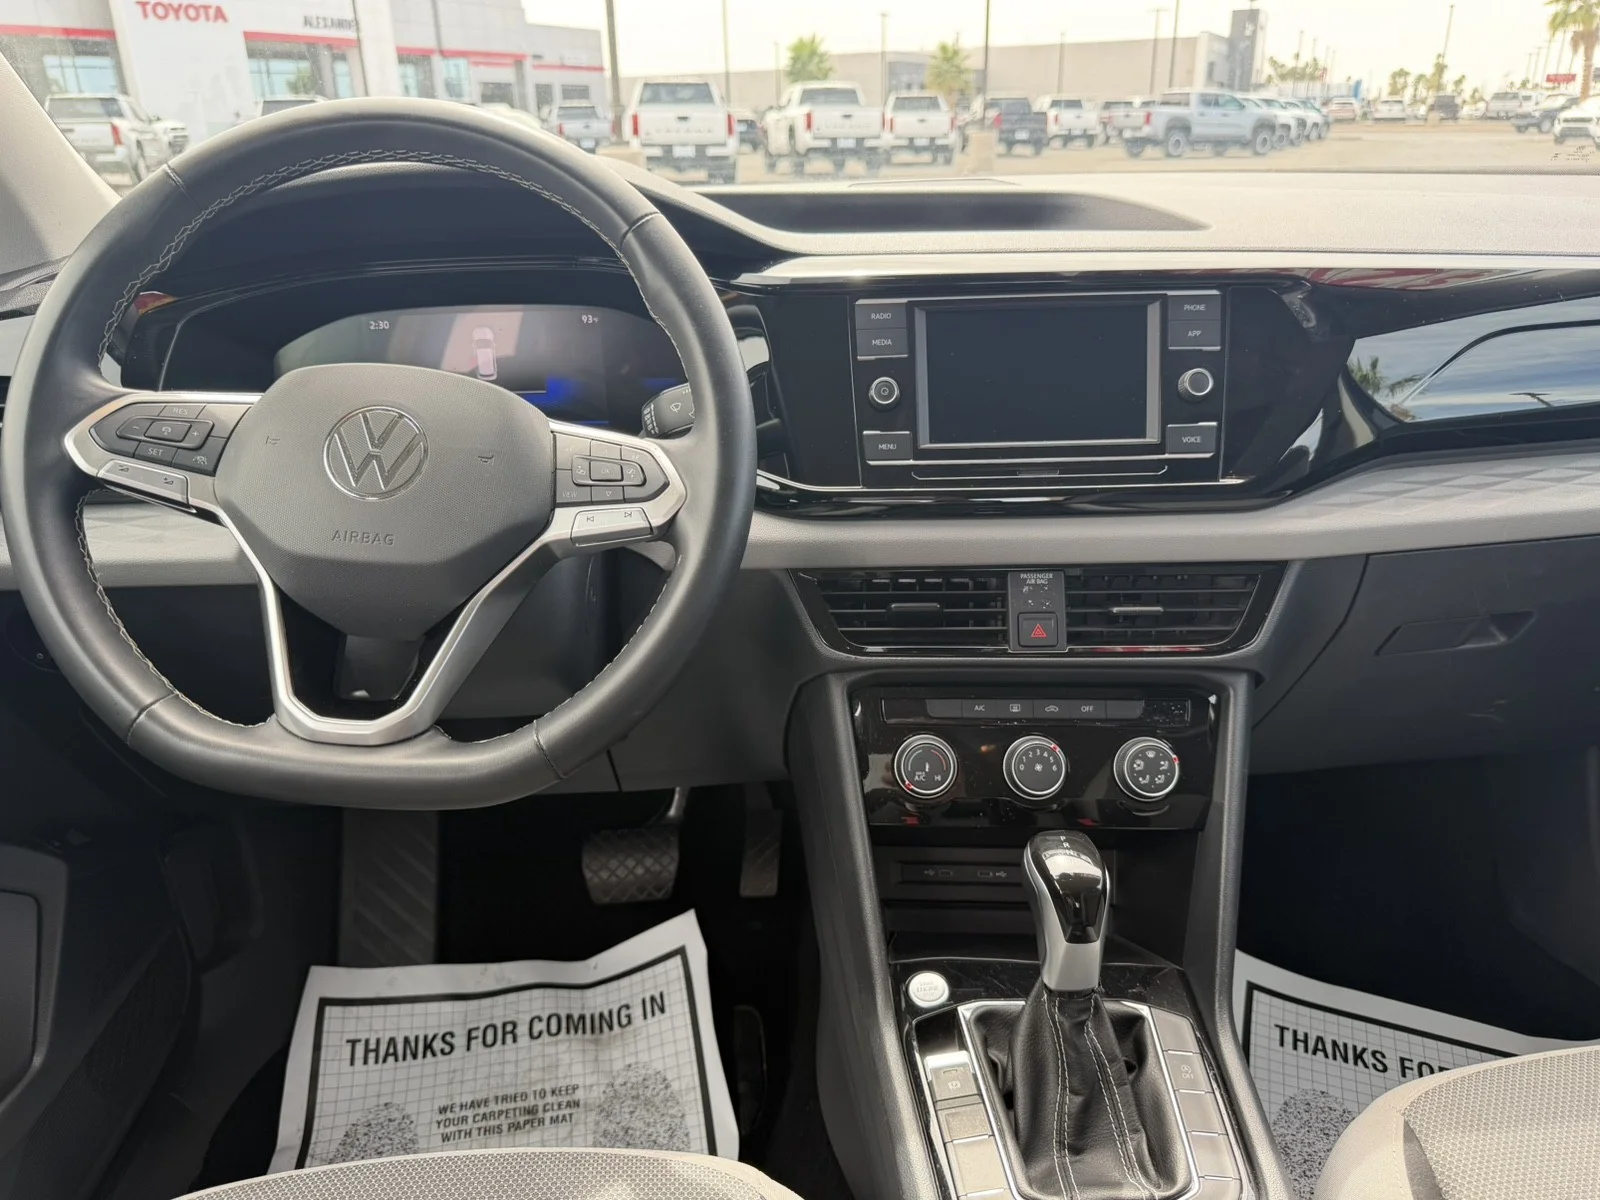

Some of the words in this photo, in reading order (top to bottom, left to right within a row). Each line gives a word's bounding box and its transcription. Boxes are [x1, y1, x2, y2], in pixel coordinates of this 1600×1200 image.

[135, 1, 228, 23] TOYOTA
[870, 312, 892, 320] RADIO
[369, 320, 390, 330] 2:30
[871, 338, 892, 346] MEDIA
[172, 407, 188, 415] RES
[1181, 435, 1201, 443] VOICE
[147, 447, 164, 456] SET
[331, 529, 394, 546] AIRBAG
[1081, 705, 1094, 713] OFF
[1052, 764, 1058, 772] 6
[346, 1031, 456, 1066] THANKS
[466, 1020, 518, 1052] FOR
[528, 1004, 633, 1040] COMING
[641, 990, 666, 1021] IN
[1273, 1023, 1389, 1074] THANKS
[1399, 1056, 1451, 1078] FO
[438, 1102, 457, 1115] WE
[459, 1097, 490, 1112] HAVE
[494, 1091, 529, 1106] TRIED
[532, 1088, 547, 1100] TO
[551, 1083, 580, 1097] KEEP
[436, 1115, 469, 1130] YOUR
[472, 1104, 539, 1124] CARPETING
[542, 1099, 581, 1113] CLEAN
[441, 1129, 472, 1143] WITH
[476, 1123, 503, 1138] THIS
[507, 1117, 545, 1133] PAPER
[550, 1112, 574, 1125] MAT
